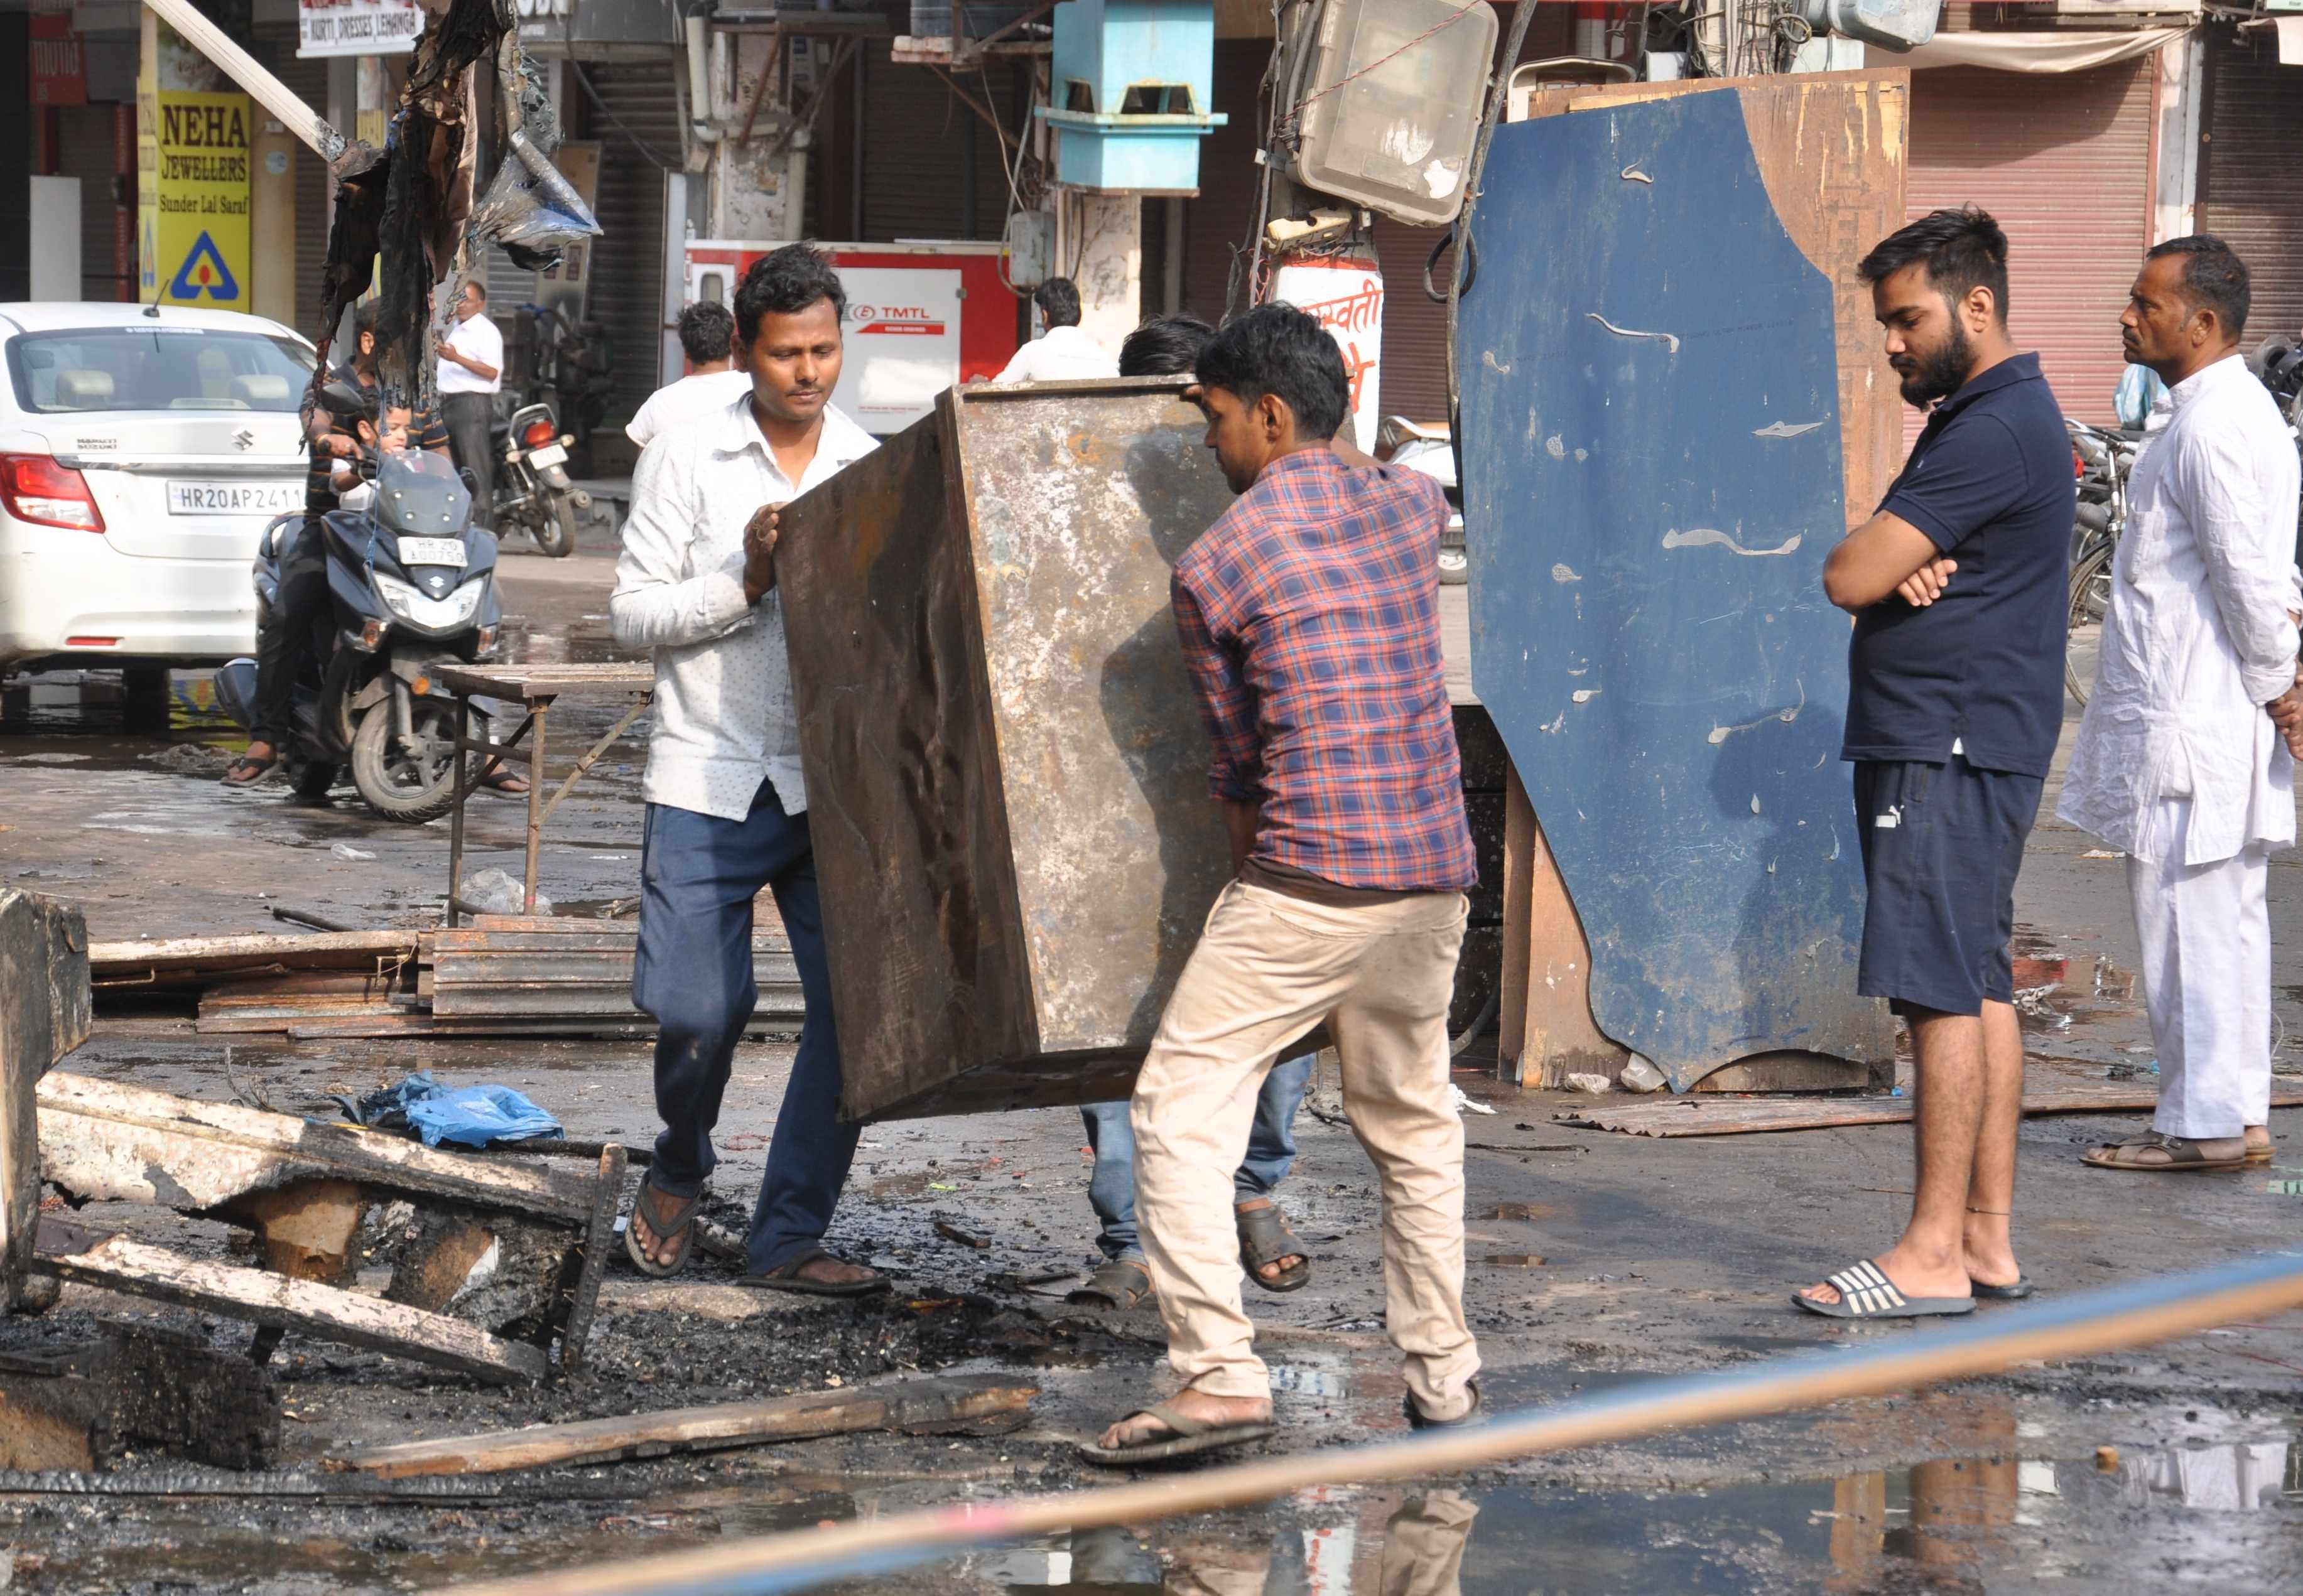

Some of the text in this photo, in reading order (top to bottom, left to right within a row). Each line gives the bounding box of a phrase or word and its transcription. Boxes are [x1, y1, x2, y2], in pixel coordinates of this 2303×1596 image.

[377, 11, 415, 36] LEHANGA
[162, 104, 247, 148] NEHA
[161, 156, 246, 181] JEWELLERS
[160, 194, 197, 212] Sunder
[201, 195, 217, 213] Lal
[220, 195, 247, 214] Saraf
[882, 306, 929, 319] TMTL
[182, 487, 301, 509] HR20AP2411
